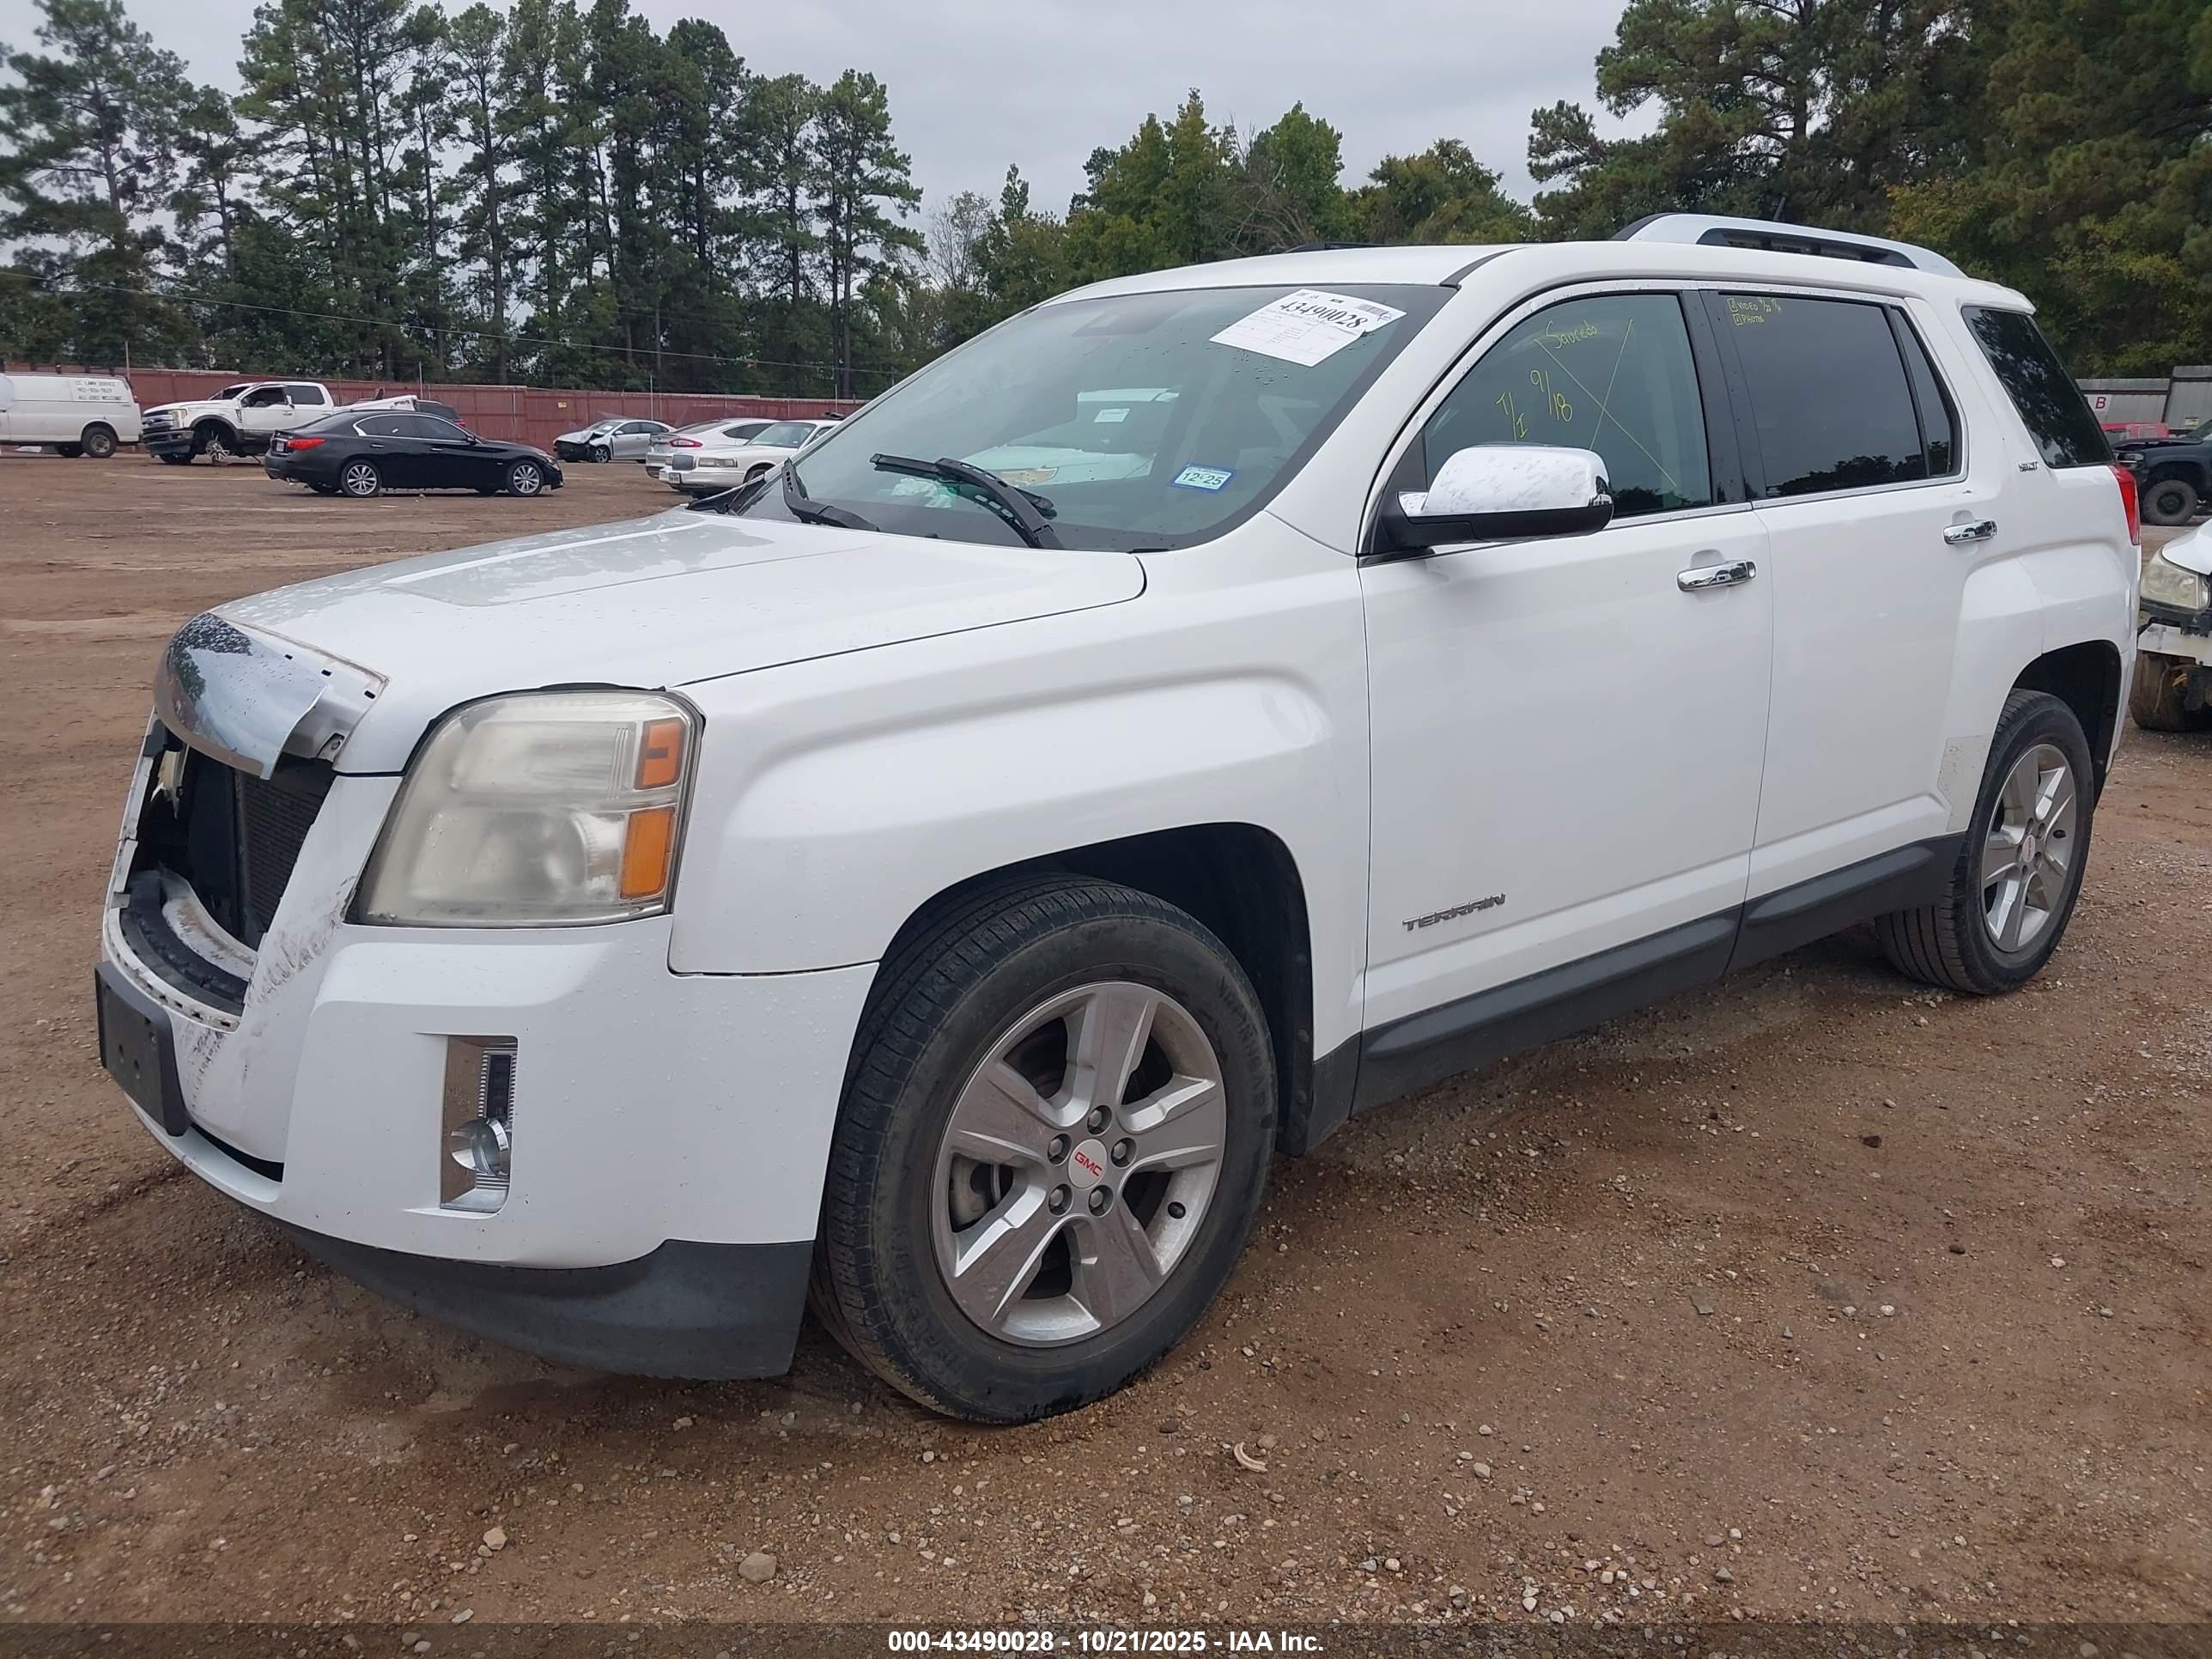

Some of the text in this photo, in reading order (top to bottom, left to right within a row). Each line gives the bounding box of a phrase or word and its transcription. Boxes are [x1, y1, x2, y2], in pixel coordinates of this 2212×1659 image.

[1279, 301, 1369, 328] 43490028
[2095, 397, 2106, 409] B
[1402, 893, 1506, 932] TERRAIN
[1074, 1152, 1103, 1176] GMC
